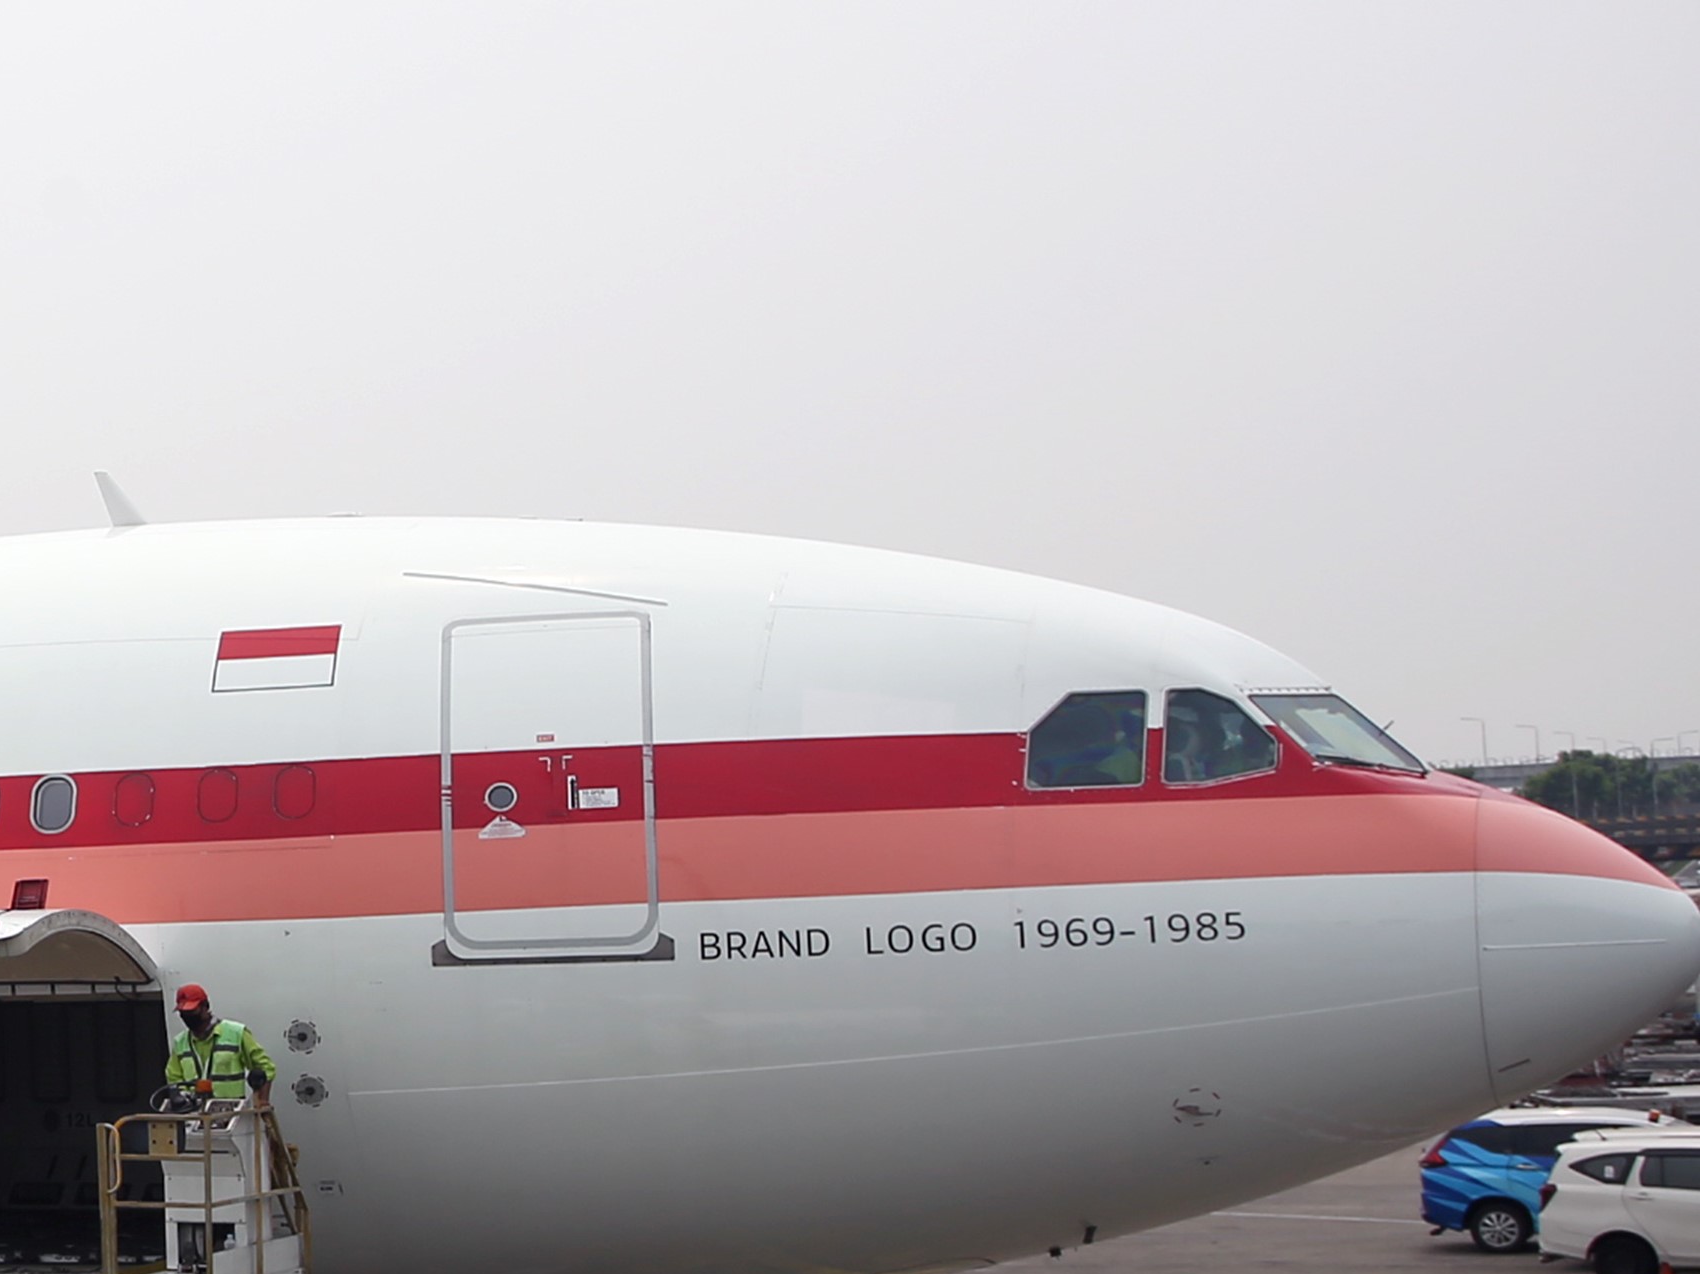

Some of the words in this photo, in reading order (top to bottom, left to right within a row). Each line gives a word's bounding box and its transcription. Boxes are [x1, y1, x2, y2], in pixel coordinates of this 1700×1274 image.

[699, 928, 831, 961] BRAND
[866, 922, 978, 955] LOGO
[1013, 911, 1247, 950] 1969-1985
